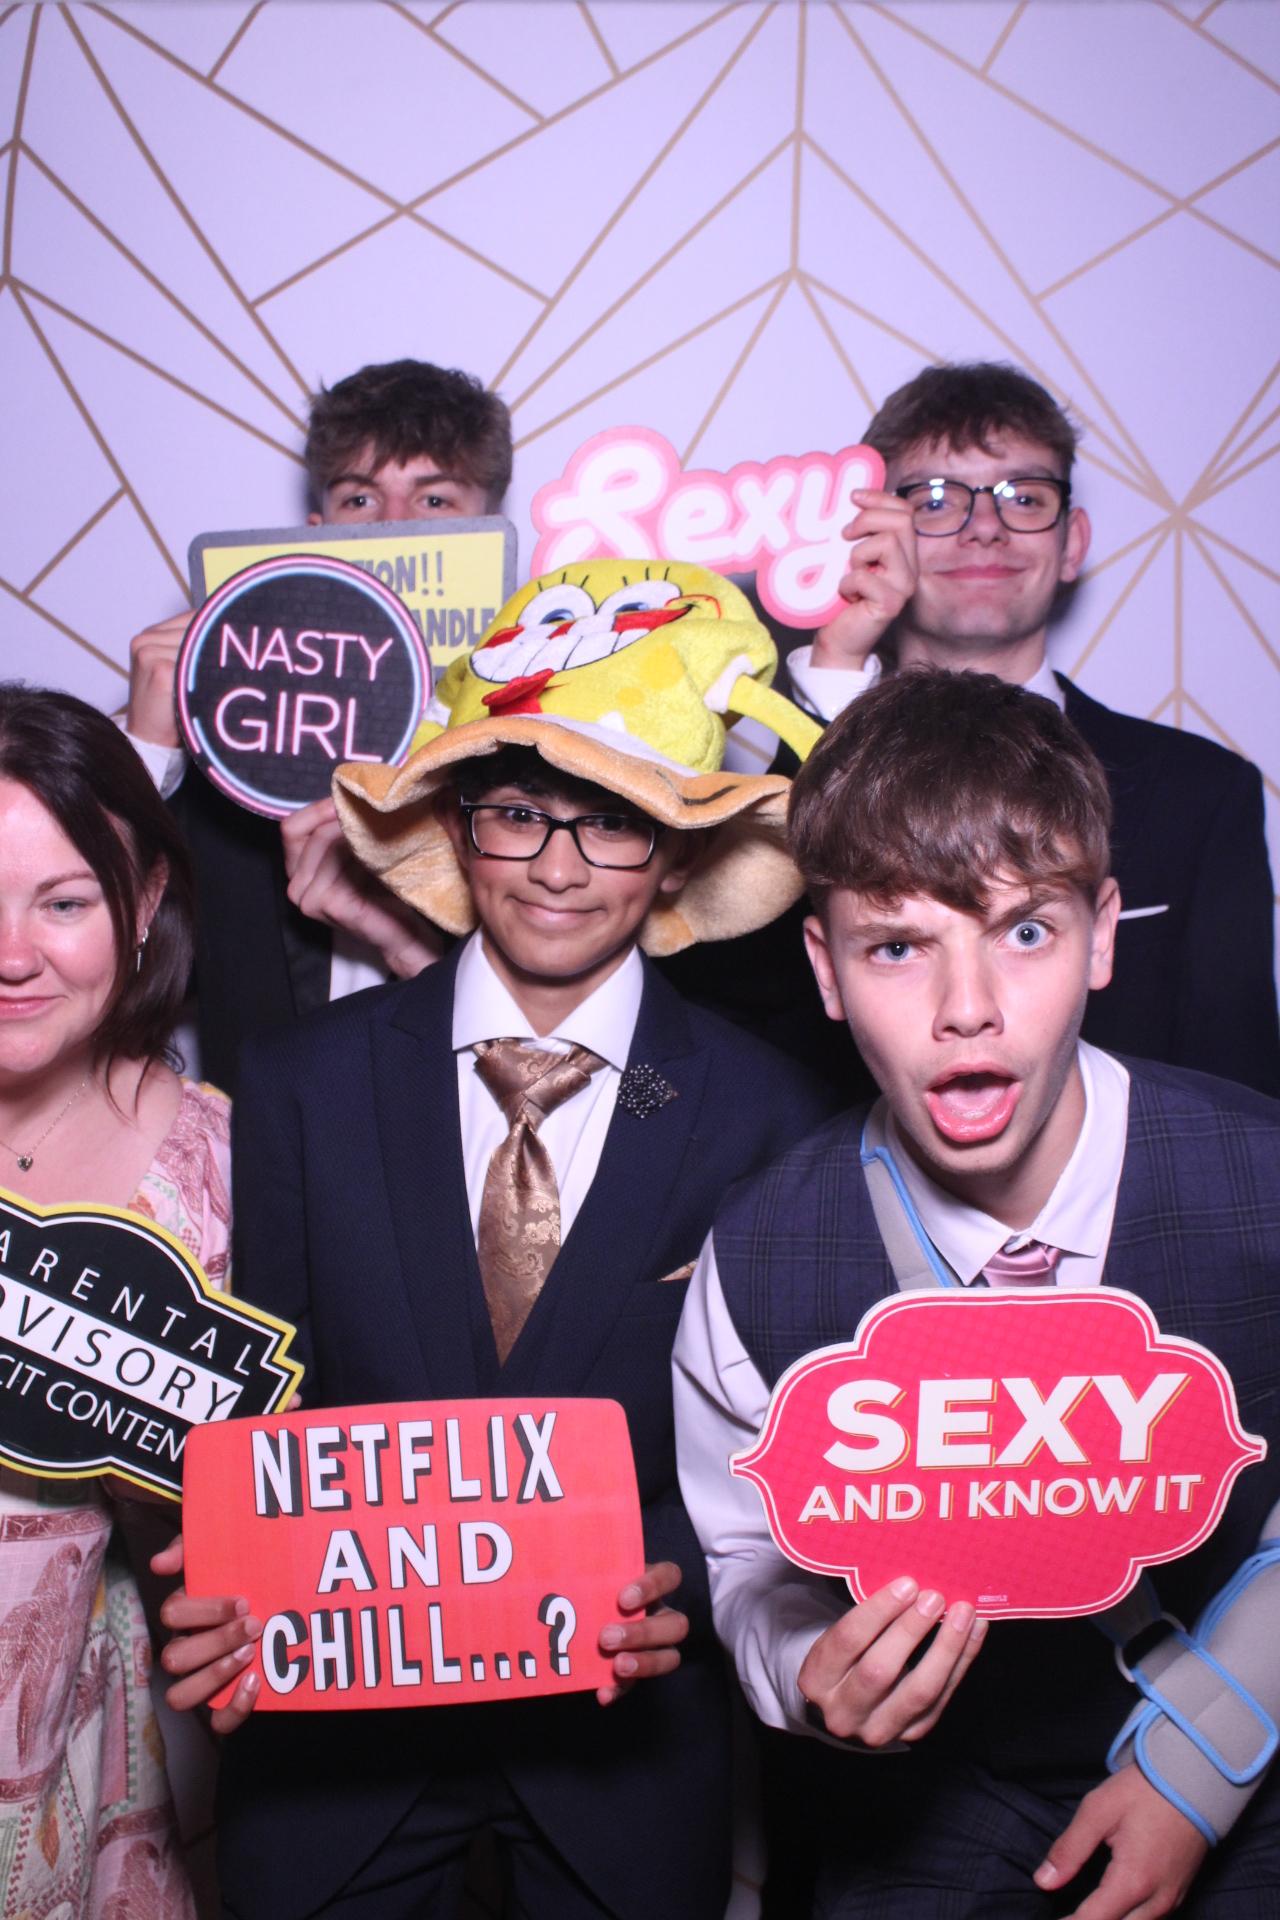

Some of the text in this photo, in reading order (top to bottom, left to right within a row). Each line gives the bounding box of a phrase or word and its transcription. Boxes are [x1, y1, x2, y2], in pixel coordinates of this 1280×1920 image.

[219, 624, 394, 682] NASTY
[215, 687, 383, 763] GIRL
[0, 1284, 238, 1423] VISORY
[250, 1411, 565, 1519] NETFLIX
[822, 1372, 1192, 1474] SEXY
[797, 1473, 1206, 1524] AND I KNOW IT
[316, 1521, 514, 1594] AND
[261, 1594, 578, 1695] CHILL...?
